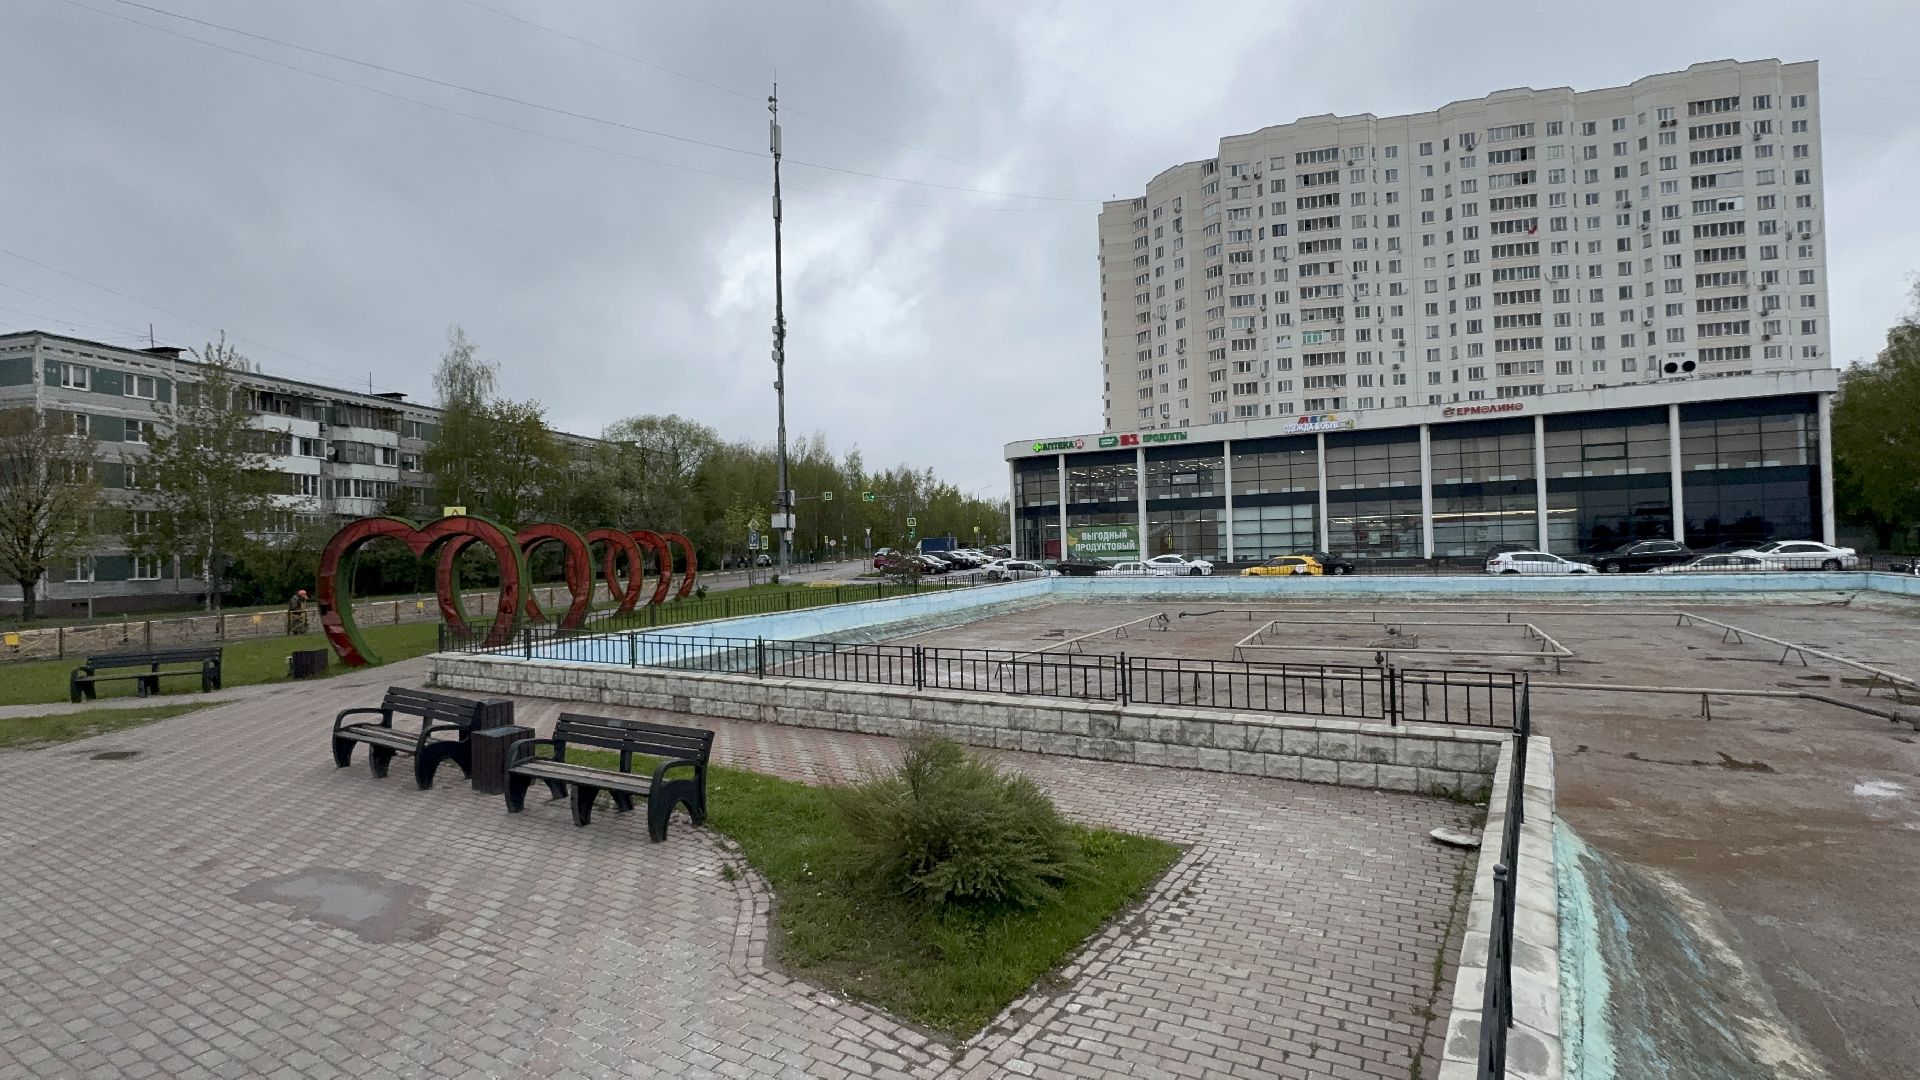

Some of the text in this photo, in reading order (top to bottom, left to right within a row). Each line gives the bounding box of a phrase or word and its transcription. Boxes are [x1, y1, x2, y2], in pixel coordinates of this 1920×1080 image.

[1143, 431, 1187, 443] ПРОДУКТЫ
[1042, 441, 1074, 450] АПТЕКА
[1081, 529, 1127, 541] ВЫГОДНЫЙ
[1075, 540, 1135, 552] ПРОДУКТОВЫЙ
